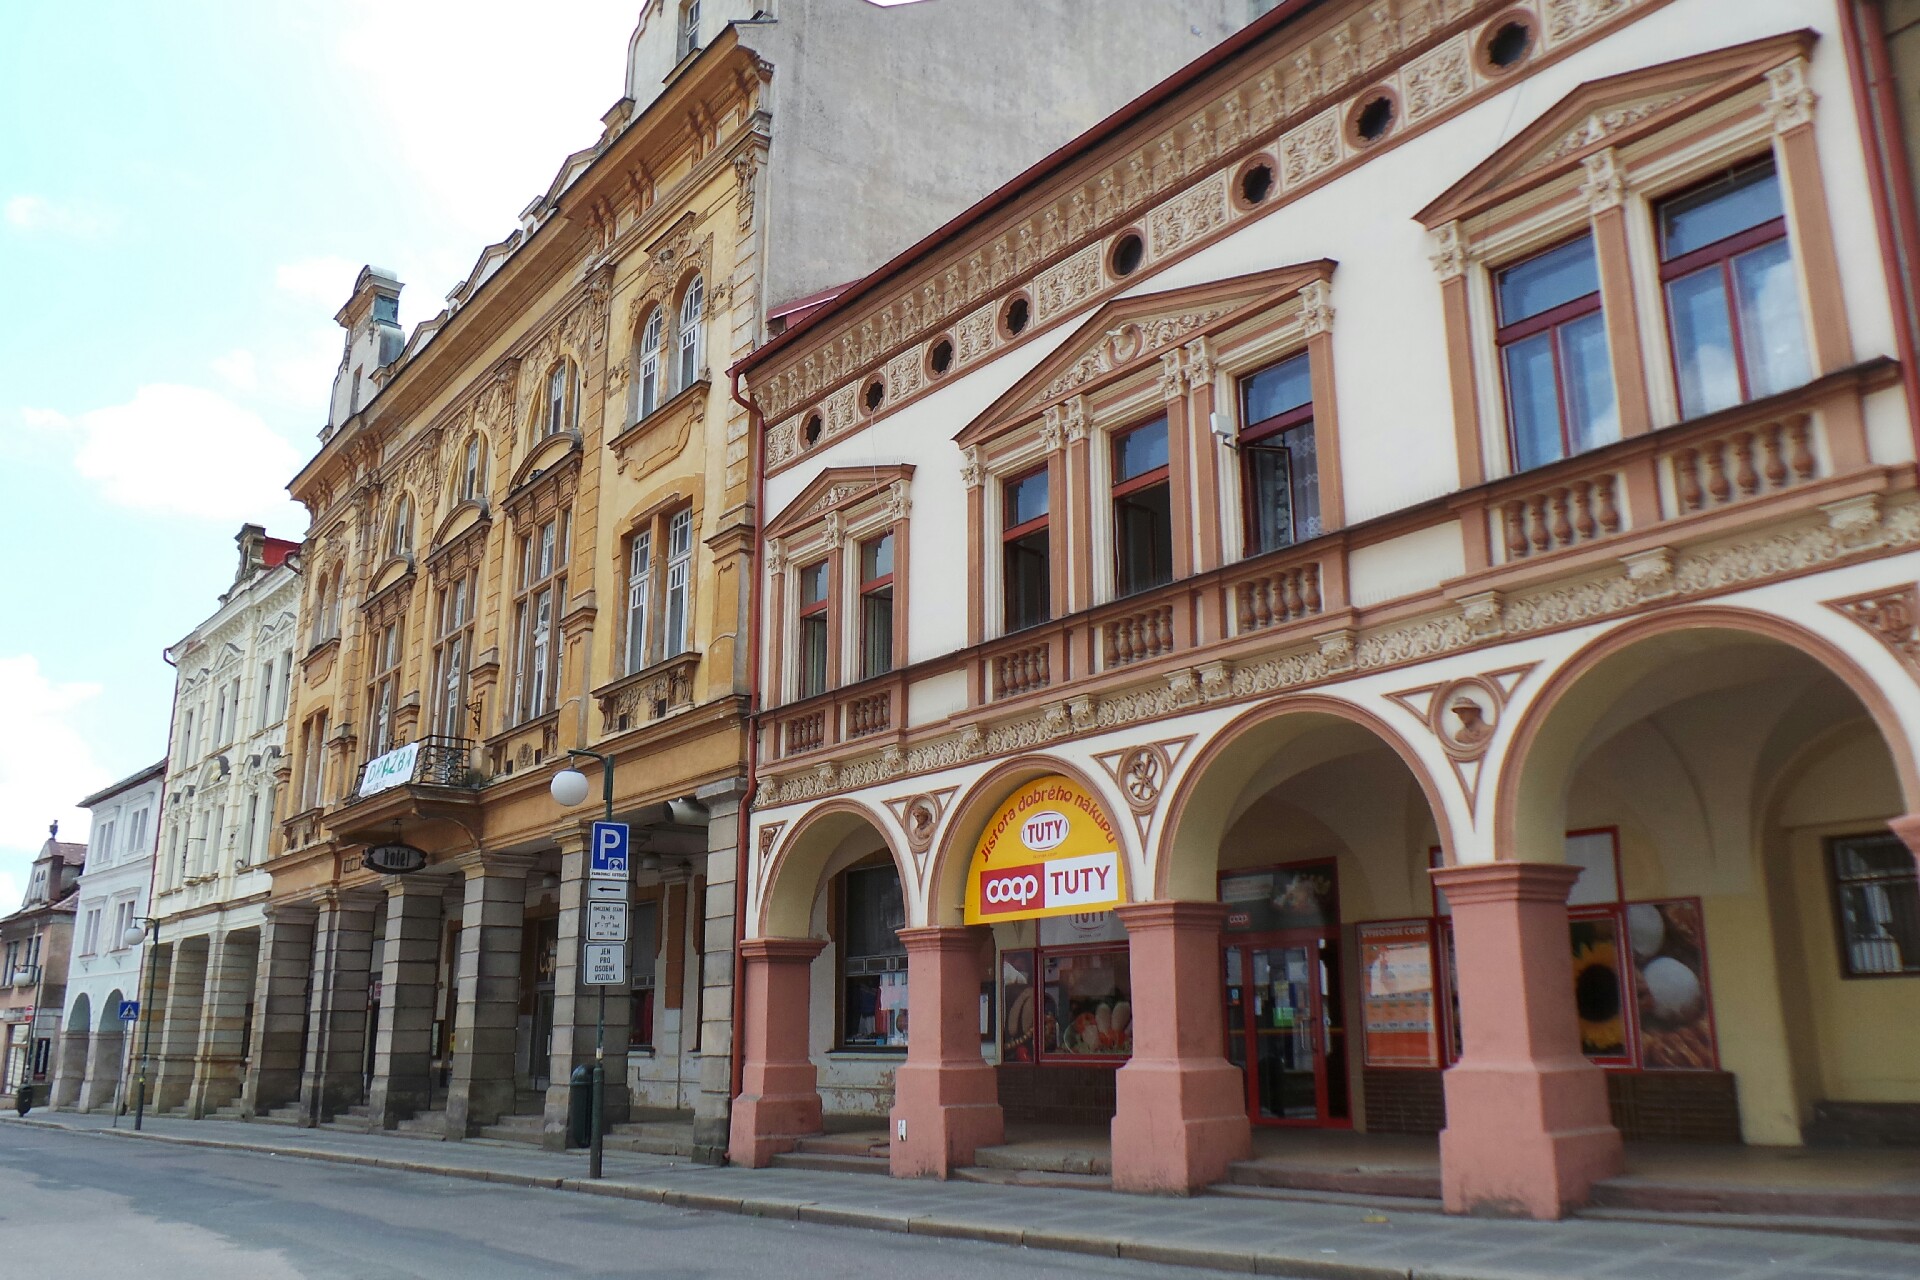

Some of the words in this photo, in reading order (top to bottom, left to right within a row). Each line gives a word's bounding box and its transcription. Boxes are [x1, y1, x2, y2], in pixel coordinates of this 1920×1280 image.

[1018, 785, 1073, 812] dobrého
[1074, 794, 1116, 844] nákupu
[600, 828, 621, 861] P
[1027, 819, 1063, 844] TUTY
[384, 848, 410, 867] hotel
[986, 874, 1038, 906] coop
[1050, 865, 1111, 896] TUTY
[599, 956, 611, 964] PRO
[600, 948, 611, 956] JEN
